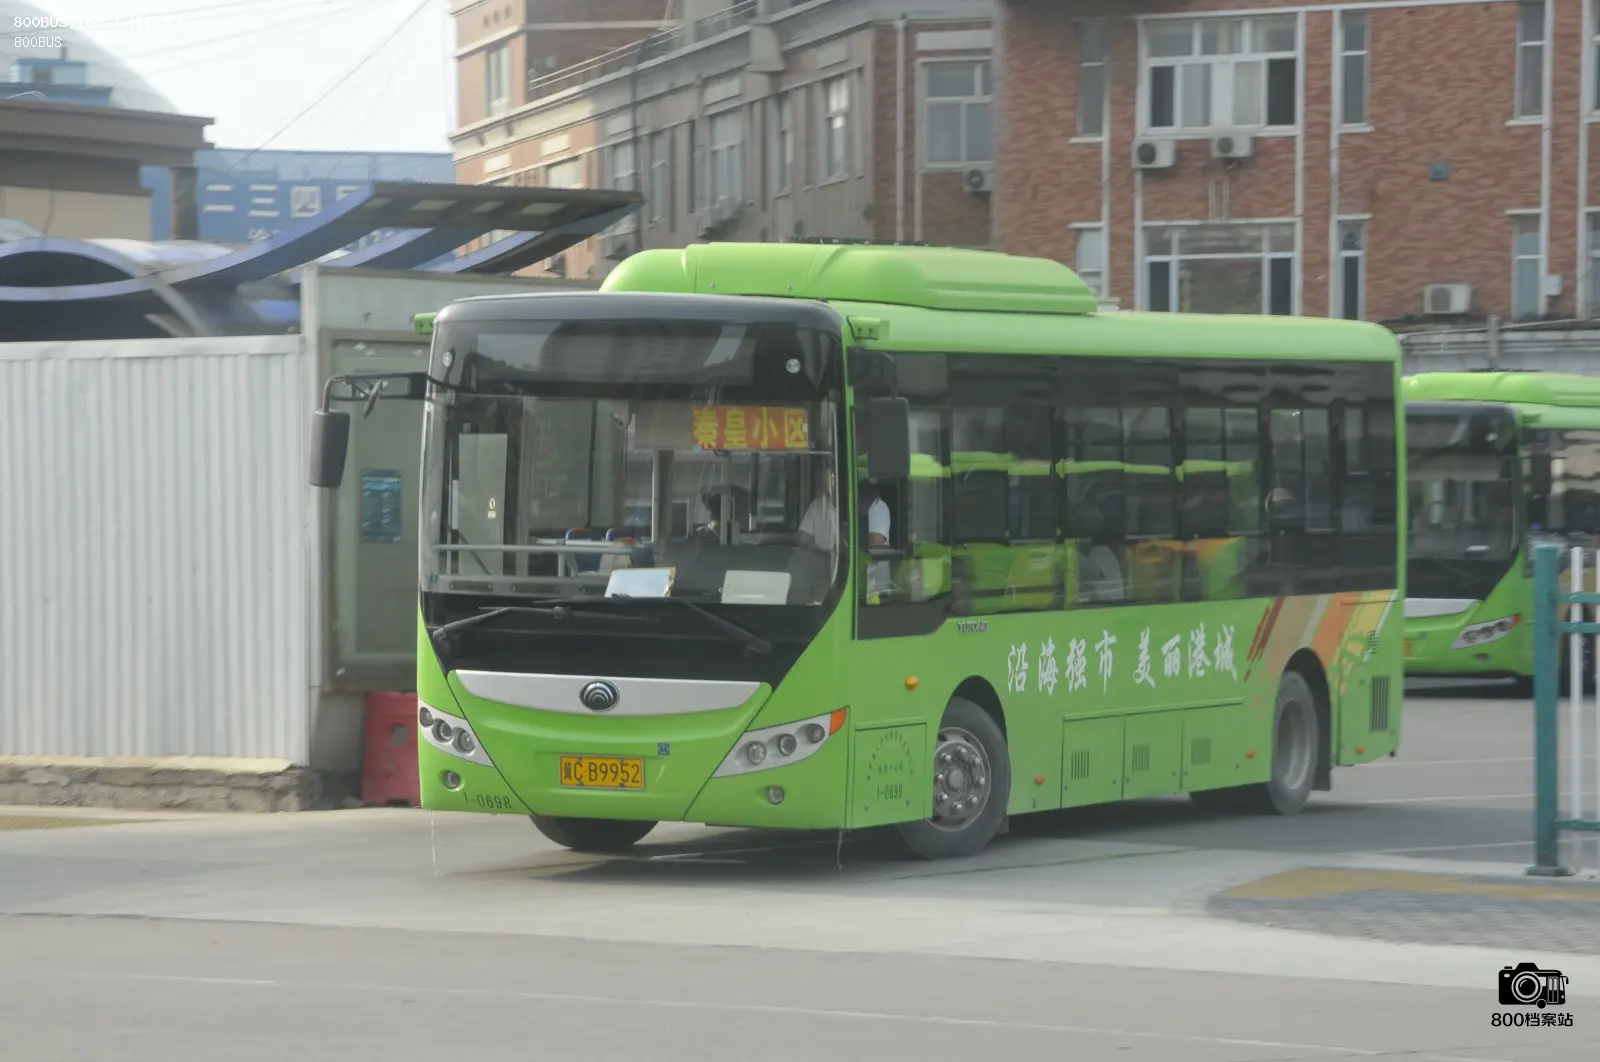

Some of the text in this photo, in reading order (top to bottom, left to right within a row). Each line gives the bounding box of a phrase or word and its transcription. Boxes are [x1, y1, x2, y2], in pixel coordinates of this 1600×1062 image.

[693, 407, 808, 450] 秦皇小区
[1007, 621, 1238, 697] 沿海强市 美丽港城
